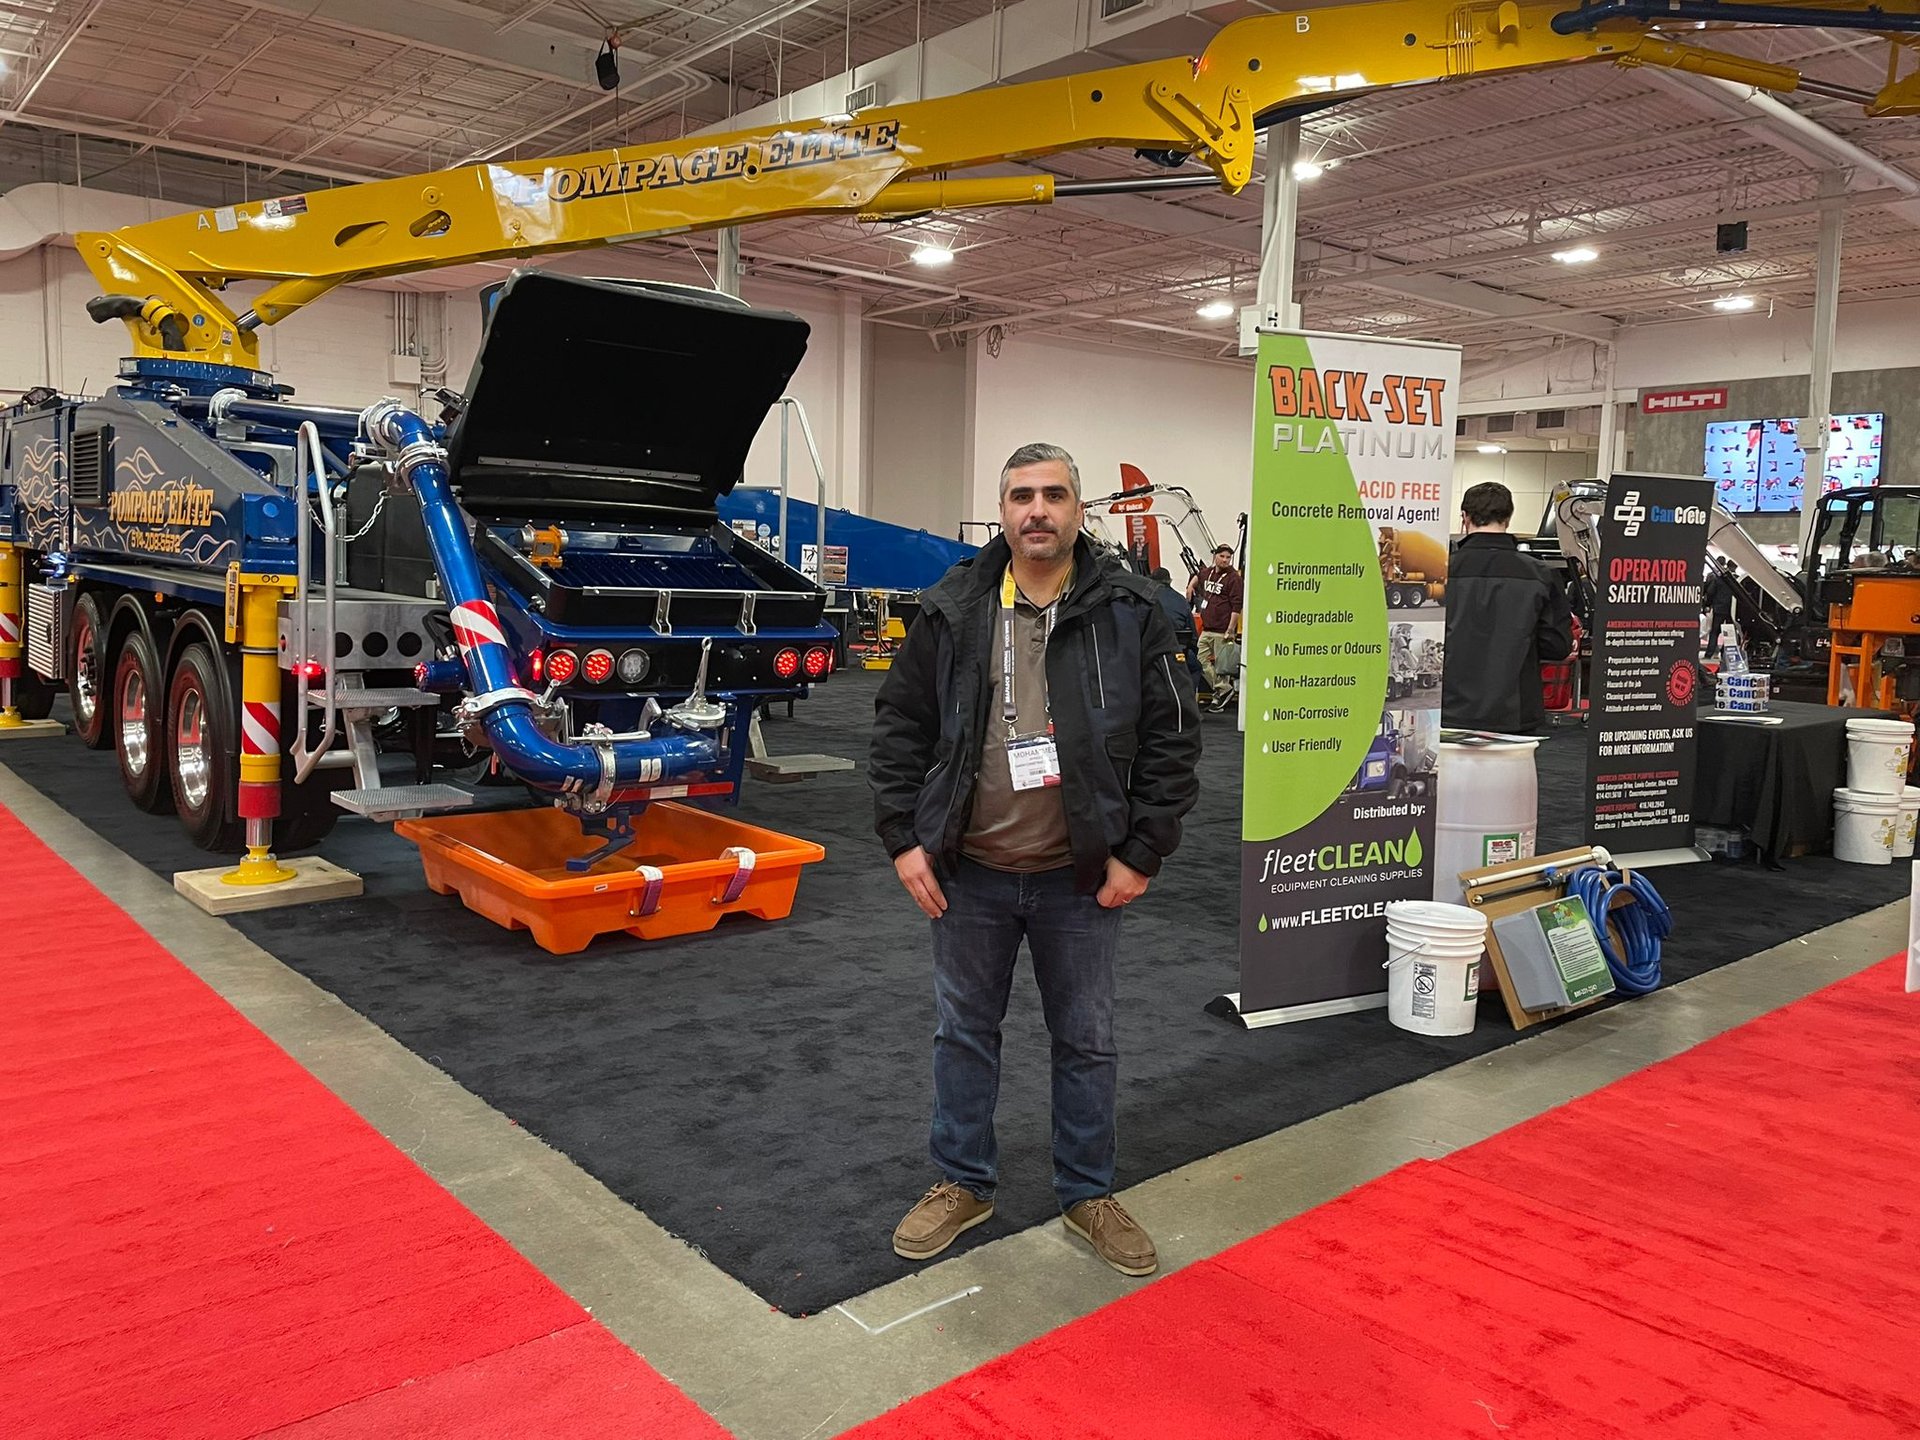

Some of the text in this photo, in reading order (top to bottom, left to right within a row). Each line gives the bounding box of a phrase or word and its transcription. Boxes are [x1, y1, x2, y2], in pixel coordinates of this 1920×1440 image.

[1296, 15, 1310, 33] B
[197, 213, 211, 231] A
[1268, 365, 1447, 427] BACK-SET
[1648, 392, 1722, 410] HILTI
[1272, 423, 1444, 460] PLATINUM
[1358, 480, 1441, 501] ACID FREE
[109, 486, 214, 527] POMPAGE ELITE
[1272, 501, 1441, 525] Concrete Removal Agent!
[1650, 505, 1707, 525] CanCrete
[1277, 562, 1365, 579] Environmentally
[1609, 558, 1688, 583] OPERATOR
[1276, 578, 1321, 593] Friendly
[1608, 584, 1701, 604] SAFETY TRAINING
[1275, 610, 1354, 626] Biodegradable
[1274, 642, 1382, 656] No Fumes or Odours
[1273, 674, 1356, 689] Non-Hazardous
[1272, 705, 1349, 721] Non-Corrosive
[1600, 727, 1693, 742] FOR UPCOMING EVENTS, ASK US
[1272, 737, 1342, 754] User Friendly
[1599, 742, 1675, 756] FOR MORE INFORMATION!
[1353, 803, 1426, 820] Distributed by:
[1259, 839, 1404, 883] fleetCLEAN
[1271, 868, 1423, 894] EQUIPMENT CLEANING SUPPLIES
[1271, 899, 1406, 931] www.FLEETCLE
